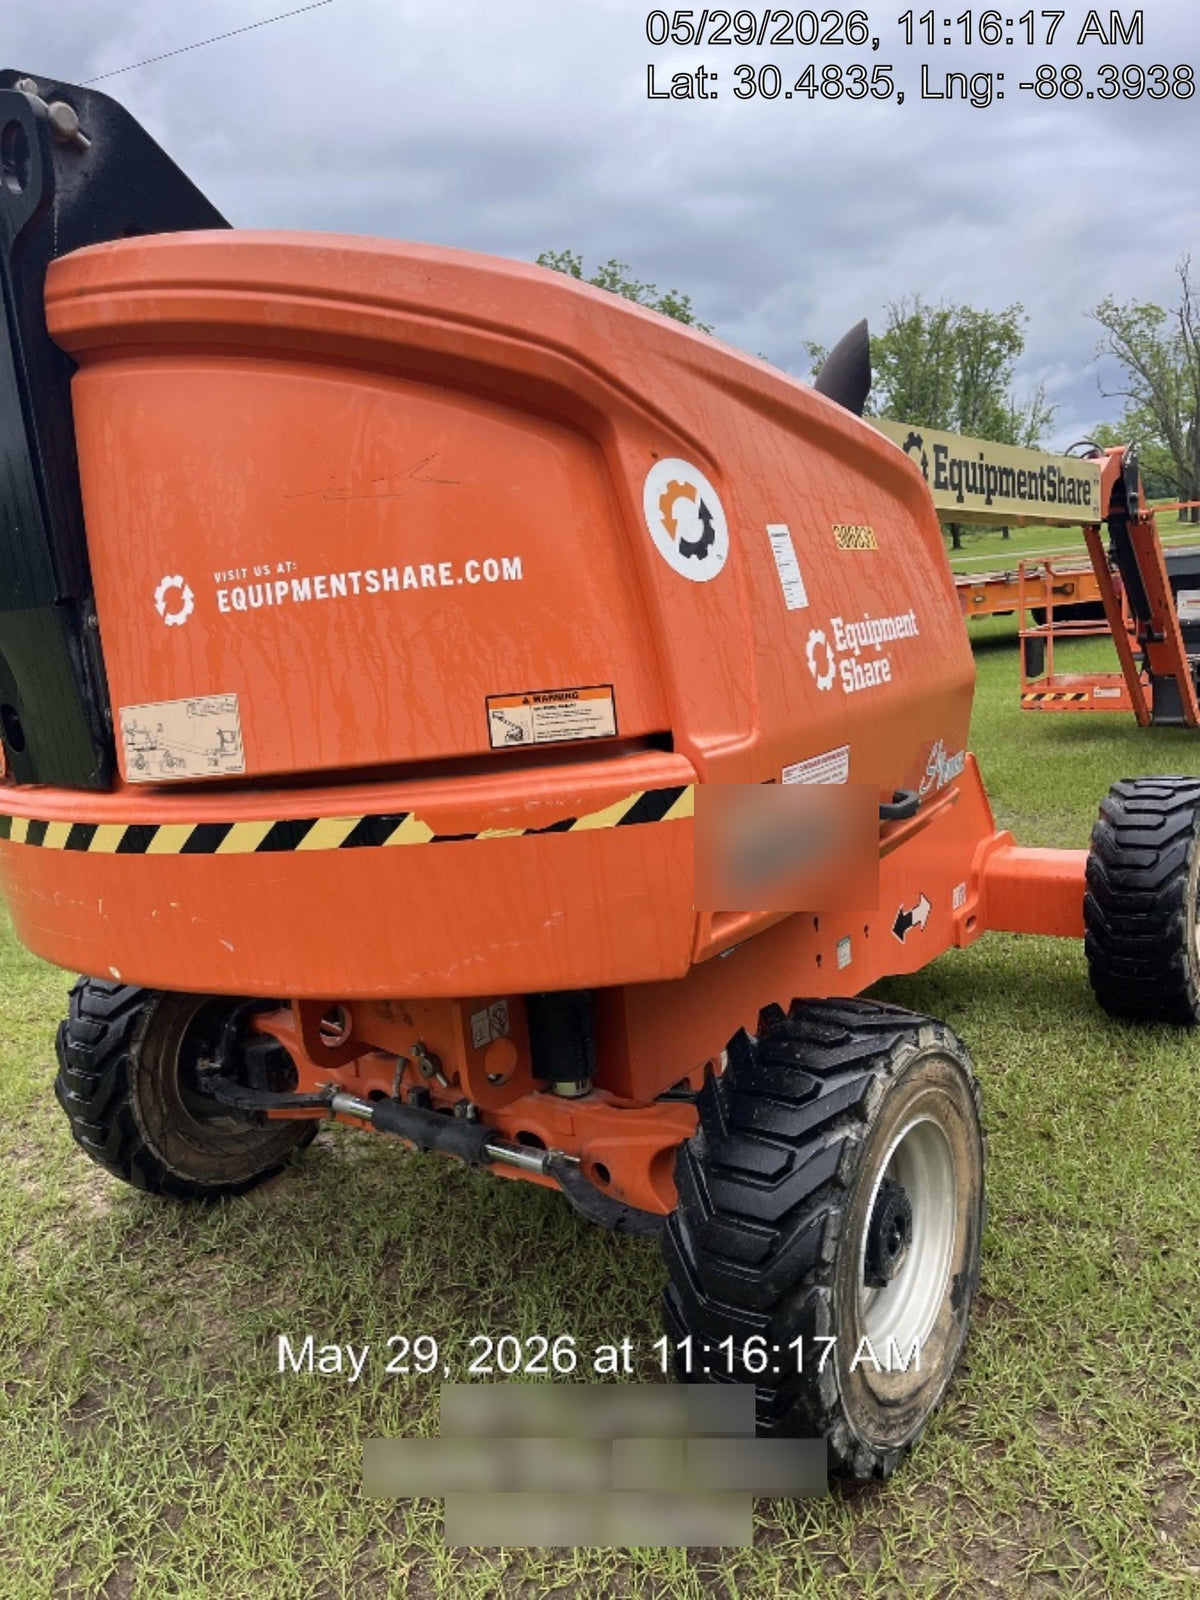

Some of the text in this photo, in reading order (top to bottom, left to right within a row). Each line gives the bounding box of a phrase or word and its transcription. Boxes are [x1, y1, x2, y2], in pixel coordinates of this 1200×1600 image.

[933, 443, 1091, 505] EquipmentShare
[214, 561, 298, 583] VISIT US AT:
[216, 556, 523, 613] EQUIPMENTSHARE.COM
[830, 609, 920, 656] Equipment
[840, 657, 892, 694] Share
